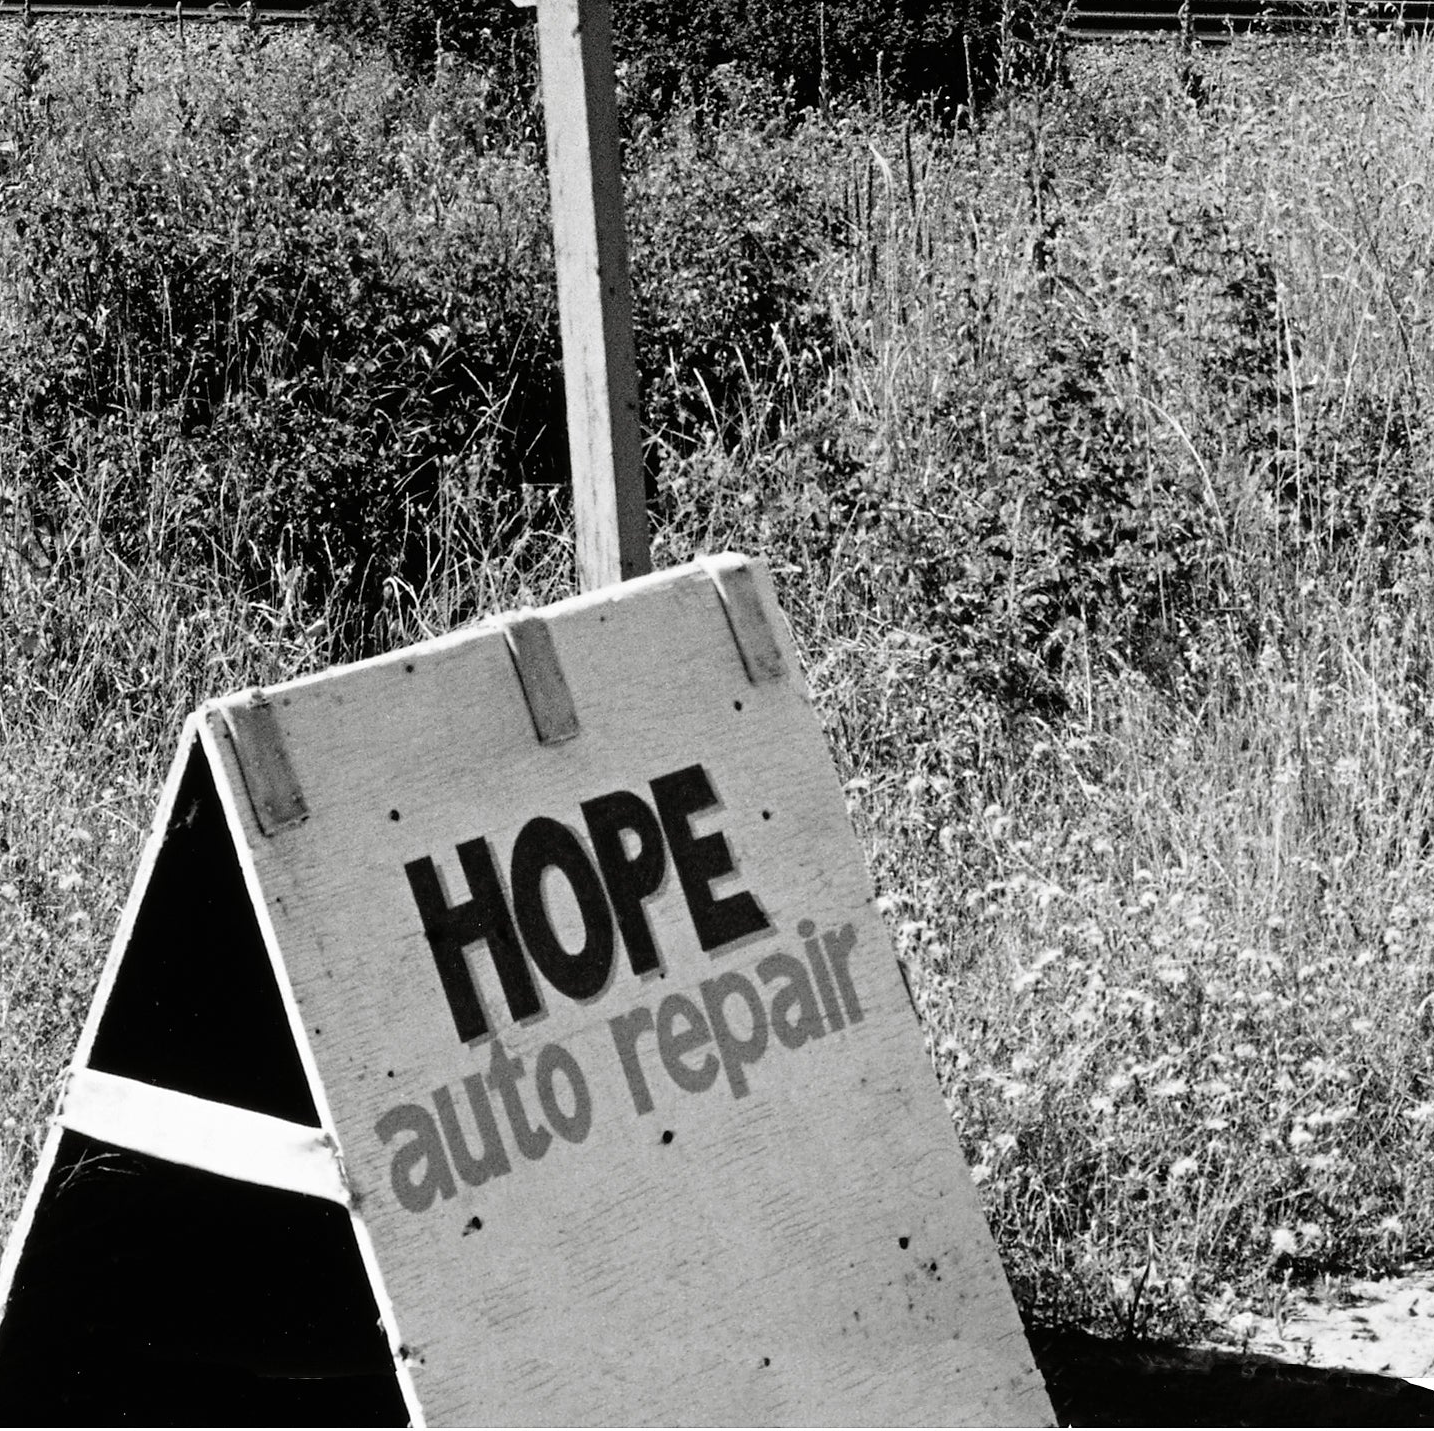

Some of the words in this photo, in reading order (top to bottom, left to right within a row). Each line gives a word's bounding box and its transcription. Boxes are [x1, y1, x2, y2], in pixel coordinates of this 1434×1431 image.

[404, 764, 778, 1047] HOPE
[373, 1039, 592, 1214] auto
[608, 918, 864, 1116] repair
